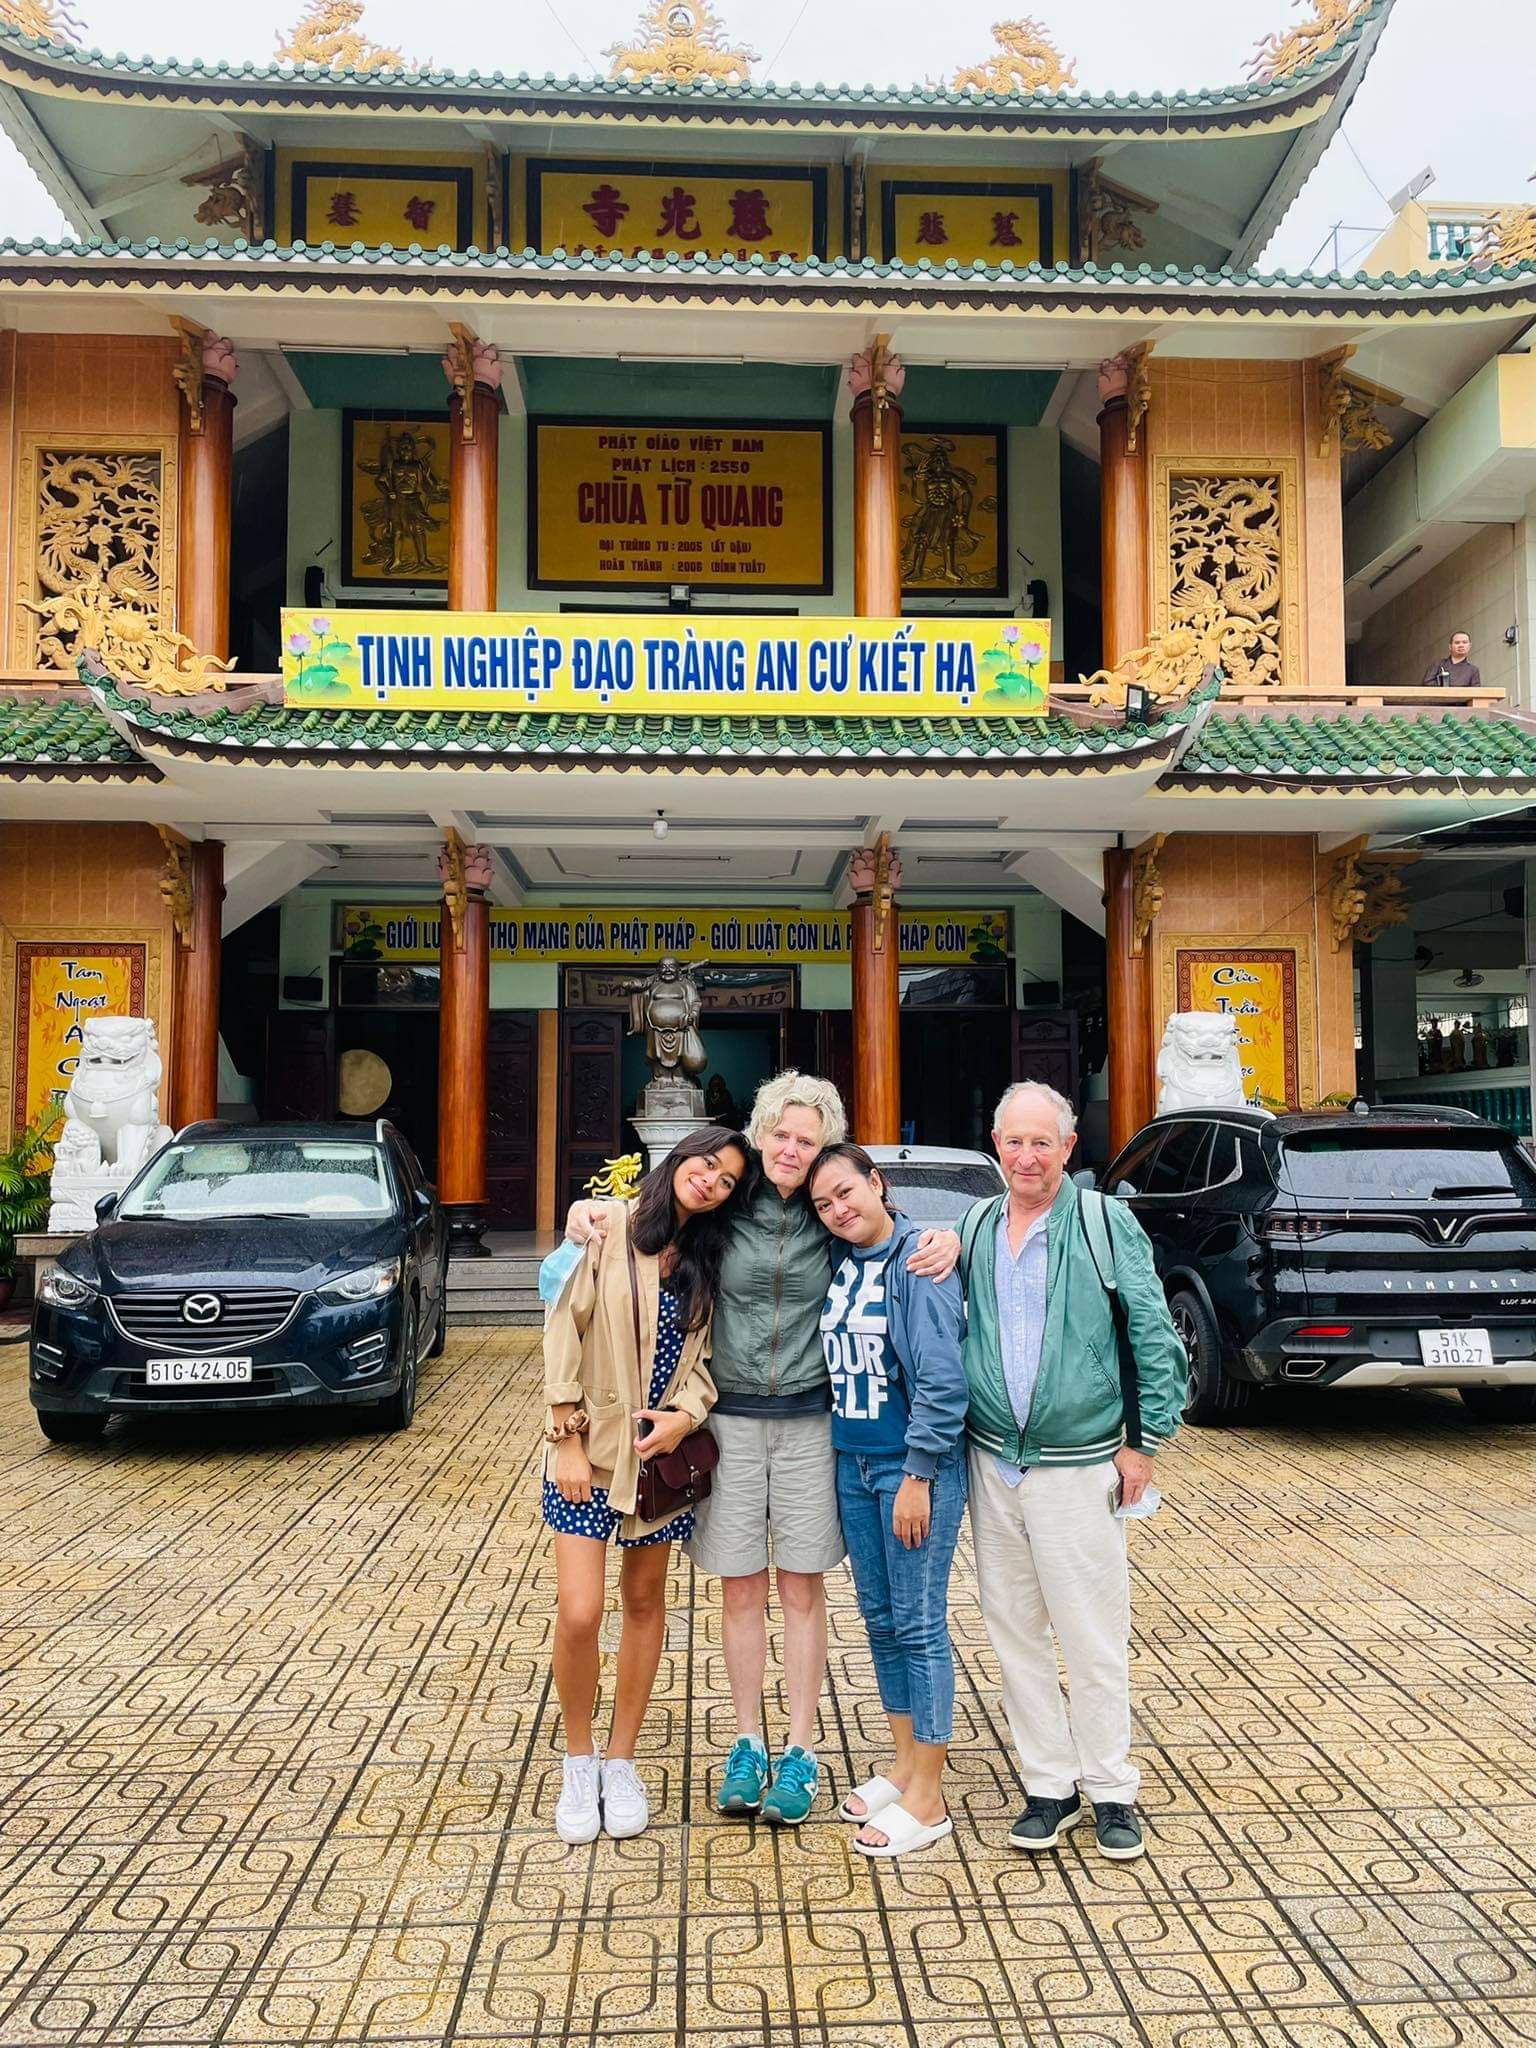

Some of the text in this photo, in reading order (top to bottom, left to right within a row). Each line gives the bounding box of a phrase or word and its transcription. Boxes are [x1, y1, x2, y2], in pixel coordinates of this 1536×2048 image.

[598, 434, 637, 451] PHẬT
[689, 435, 723, 454] VIỆT
[732, 438, 764, 452] NAM
[612, 456, 652, 474] PHẬT
[661, 457, 695, 475] LỊCH
[710, 460, 749, 474] 2550
[577, 476, 783, 531] CHÙA TỪ QUANG
[357, 625, 977, 704] TỊNH NGHIỆP ĐẠO TRÀNG AN CƯ KIẾT HẠ
[386, 914, 418, 949] GIỚI
[423, 921, 441, 949] LU
[488, 921, 518, 955] THỌ
[524, 921, 569, 955] MẠNG
[575, 914, 605, 950] CỦA
[611, 917, 649, 956] PHẬT
[655, 917, 695, 950] PHÁP
[711, 915, 741, 950] GIỚI
[747, 917, 786, 957] LUẬT
[787, 917, 818, 950] CÒN
[823, 917, 841, 950] LÀ
[900, 918, 931, 951] HÁP
[935, 918, 966, 951] CÒN
[61, 961, 102, 981] Tam
[1383, 1278, 1518, 1290] VINFAST
[819, 1257, 888, 1334] BE
[1500, 1298, 1519, 1306] LUX
[1439, 1332, 1469, 1347] 51K
[820, 1331, 887, 1376] OUR
[1431, 1348, 1482, 1364] 310.27
[151, 1361, 248, 1381] 51G-424.05
[830, 1373, 889, 1419] ELF
